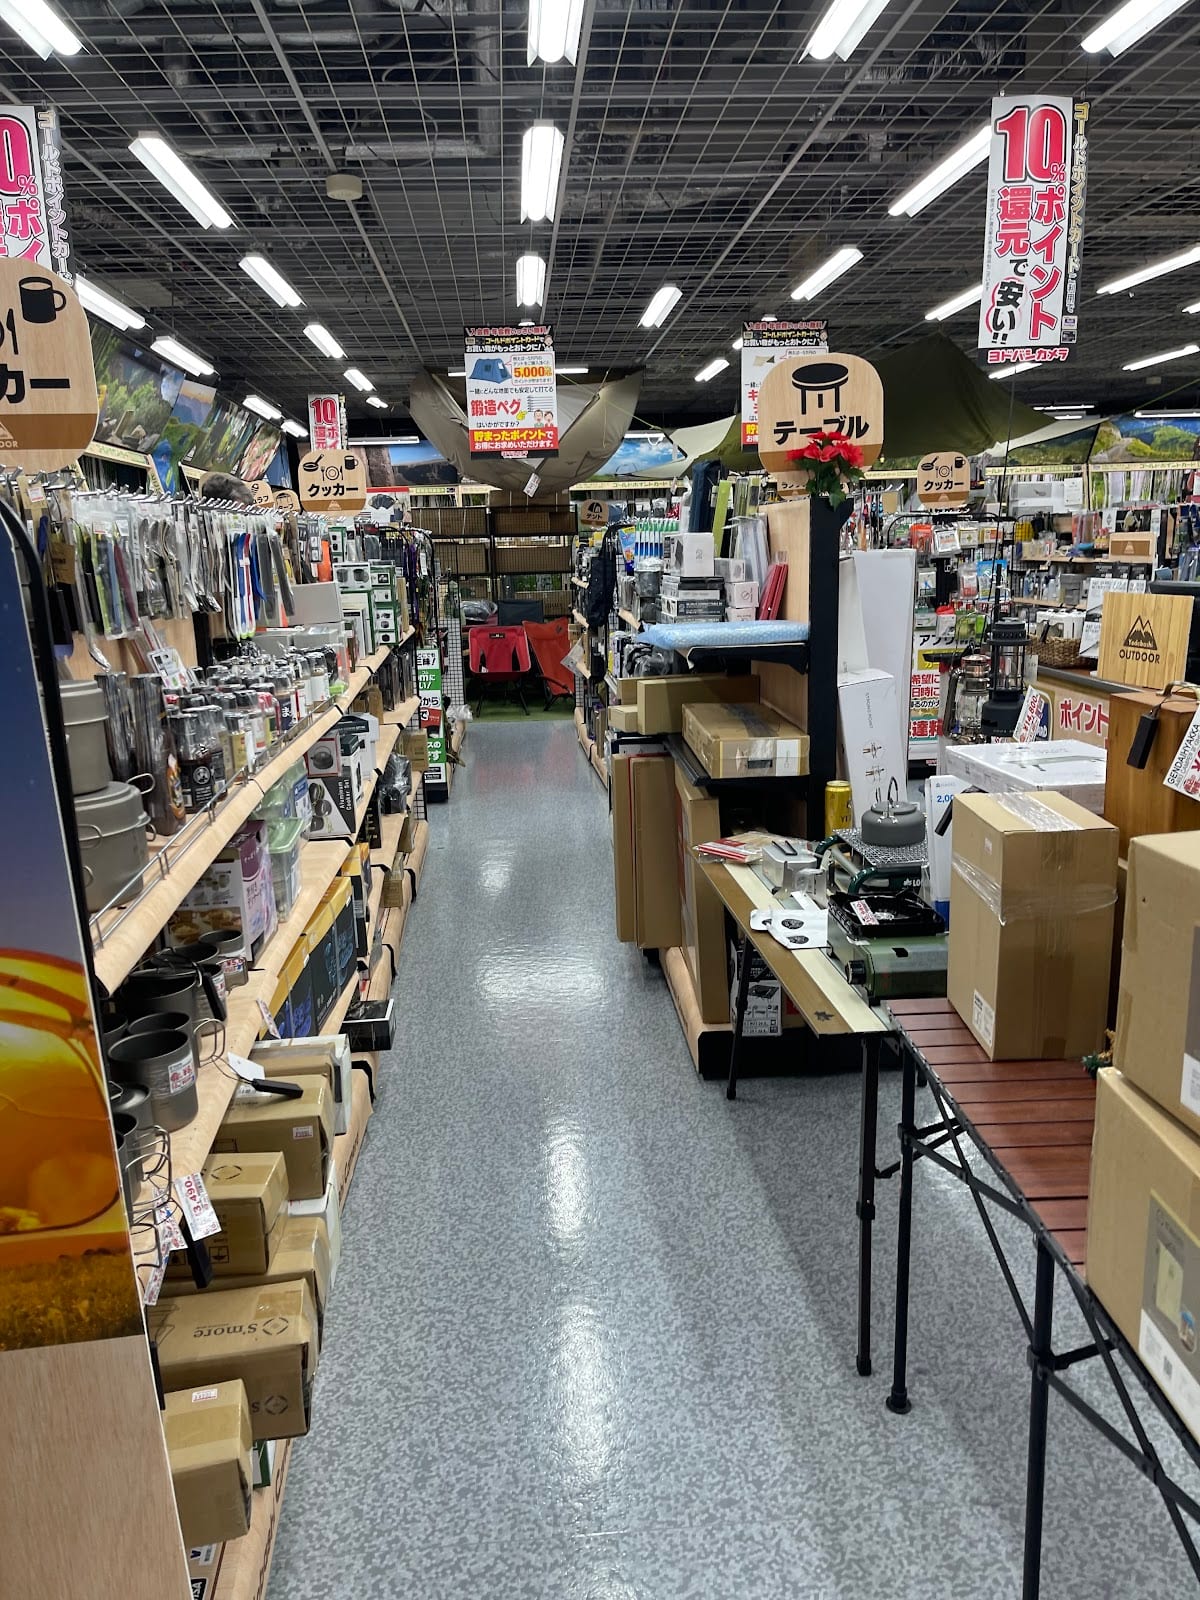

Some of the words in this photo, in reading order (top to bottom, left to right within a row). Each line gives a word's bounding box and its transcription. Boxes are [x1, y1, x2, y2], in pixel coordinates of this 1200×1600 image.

[996, 106, 1067, 183] 10%
[1029, 184, 1066, 340] ポイント
[987, 347, 1069, 364] ヨドバシカメラ
[514, 366, 545, 378] 5,000
[470, 398, 521, 417] 鍛造ペグ
[474, 429, 554, 441] 貯まったポイントで
[773, 415, 870, 446] テーブル
[307, 482, 359, 498] クッカー
[924, 479, 964, 491] クッカー
[1119, 649, 1161, 664] OUTDOOR
[1060, 699, 1110, 734] ポイント
[1167, 723, 1200, 785] GENDAIHYAKKA
[193, 1320, 258, 1339] S'more
